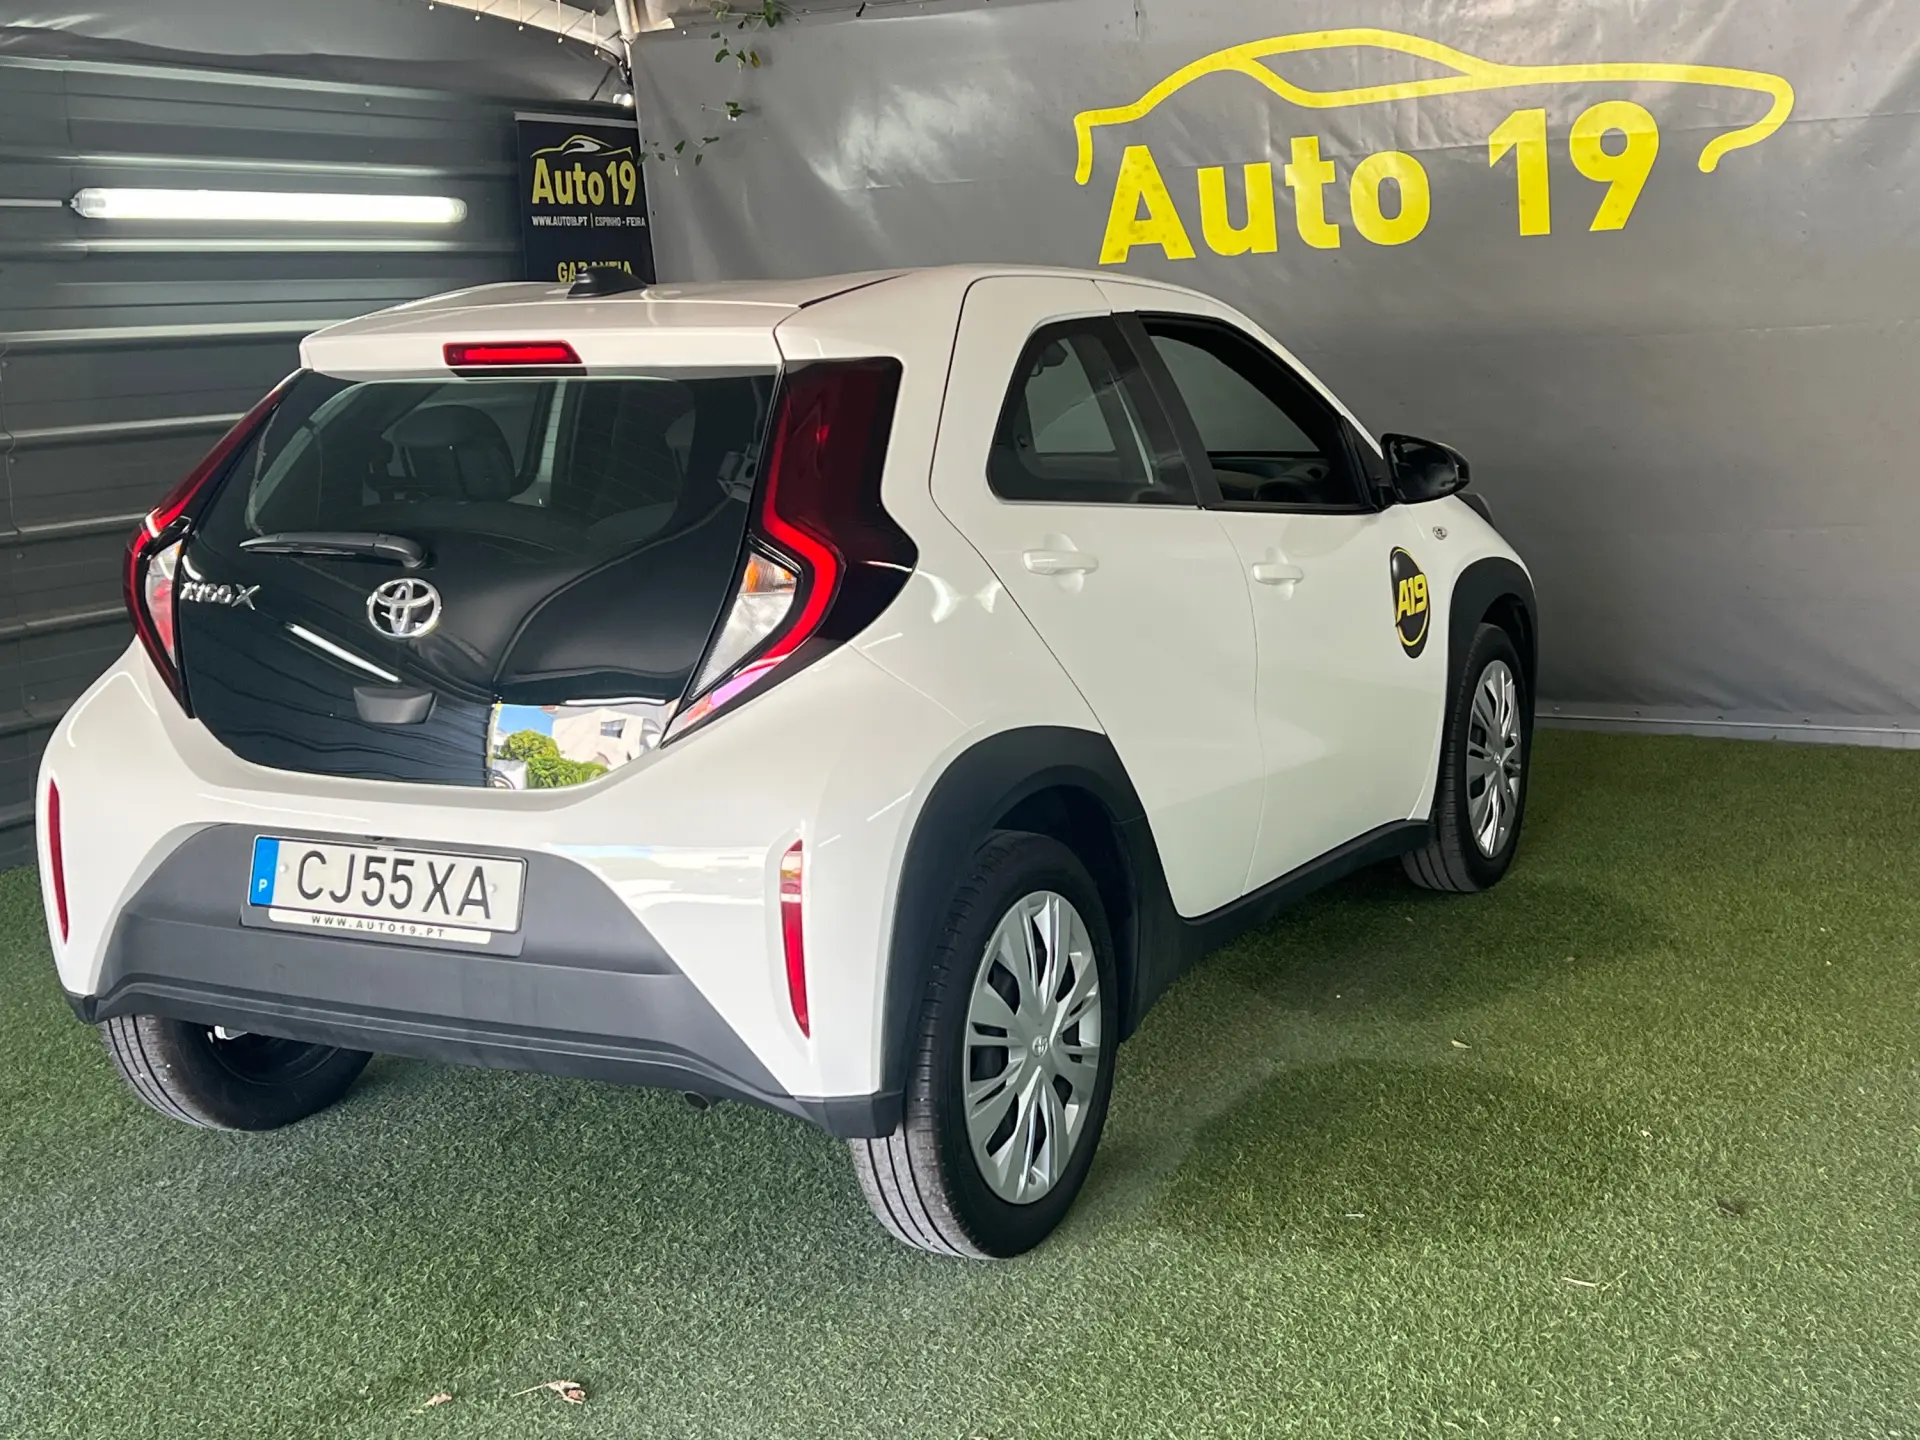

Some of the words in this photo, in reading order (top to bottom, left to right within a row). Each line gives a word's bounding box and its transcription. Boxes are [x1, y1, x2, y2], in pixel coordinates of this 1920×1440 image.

[531, 158, 605, 206] Auto
[606, 160, 637, 206] 19
[1098, 136, 1431, 265] Auto
[1488, 101, 1660, 236] 19
[595, 216, 622, 227] ESPINHO
[625, 216, 646, 227] FEIRA
[1396, 573, 1428, 622] A19
[258, 878, 268, 893] P
[311, 915, 445, 938] WWW.AUTO19.PT
